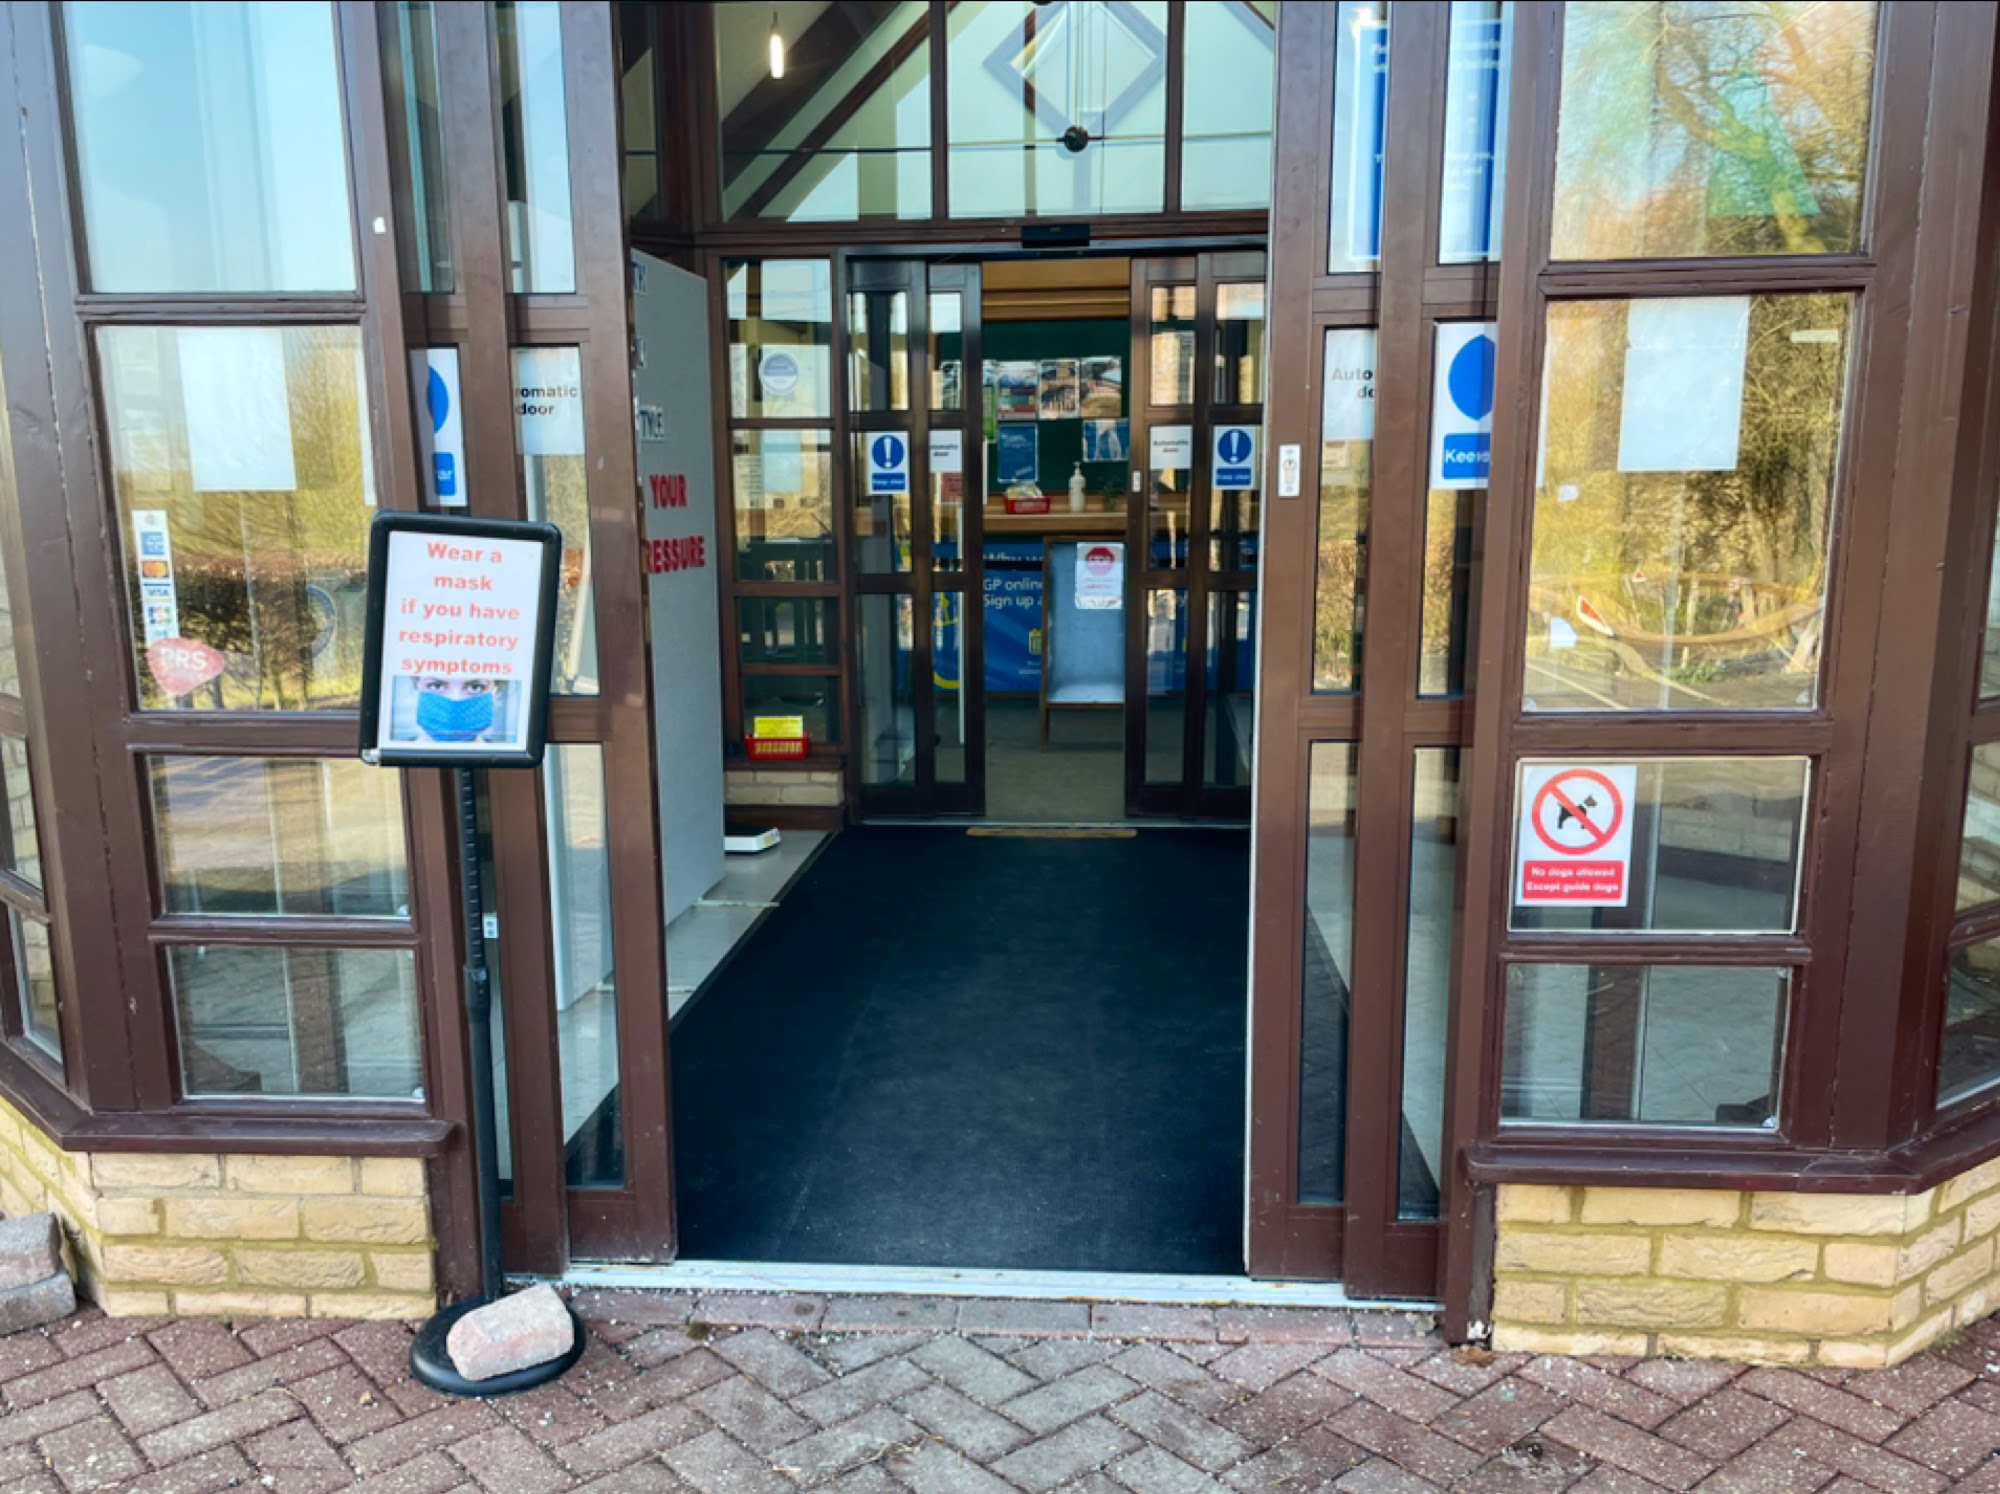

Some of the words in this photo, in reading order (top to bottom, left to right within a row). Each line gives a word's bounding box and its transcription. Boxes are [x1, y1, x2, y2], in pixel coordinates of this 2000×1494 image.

[519, 384, 578, 398] omatic
[650, 473, 687, 509] YOUR
[427, 542, 484, 561] Wear
[490, 549, 503, 563] a
[646, 535, 706, 574] RESSURE
[434, 575, 493, 591] mask
[1005, 577, 1043, 591] onlin
[401, 598, 416, 614] if
[424, 604, 462, 619] you
[470, 602, 520, 619] have
[1016, 596, 1033, 610] up
[399, 629, 519, 651] respiratory
[401, 658, 514, 675] symptoms
[1531, 867, 1545, 877] No
[1548, 867, 1573, 878] dogs
[1576, 867, 1615, 877] allowed
[1526, 881, 1560, 892] Except
[1563, 881, 1591, 893] guide
[1593, 881, 1618, 893] dogs
